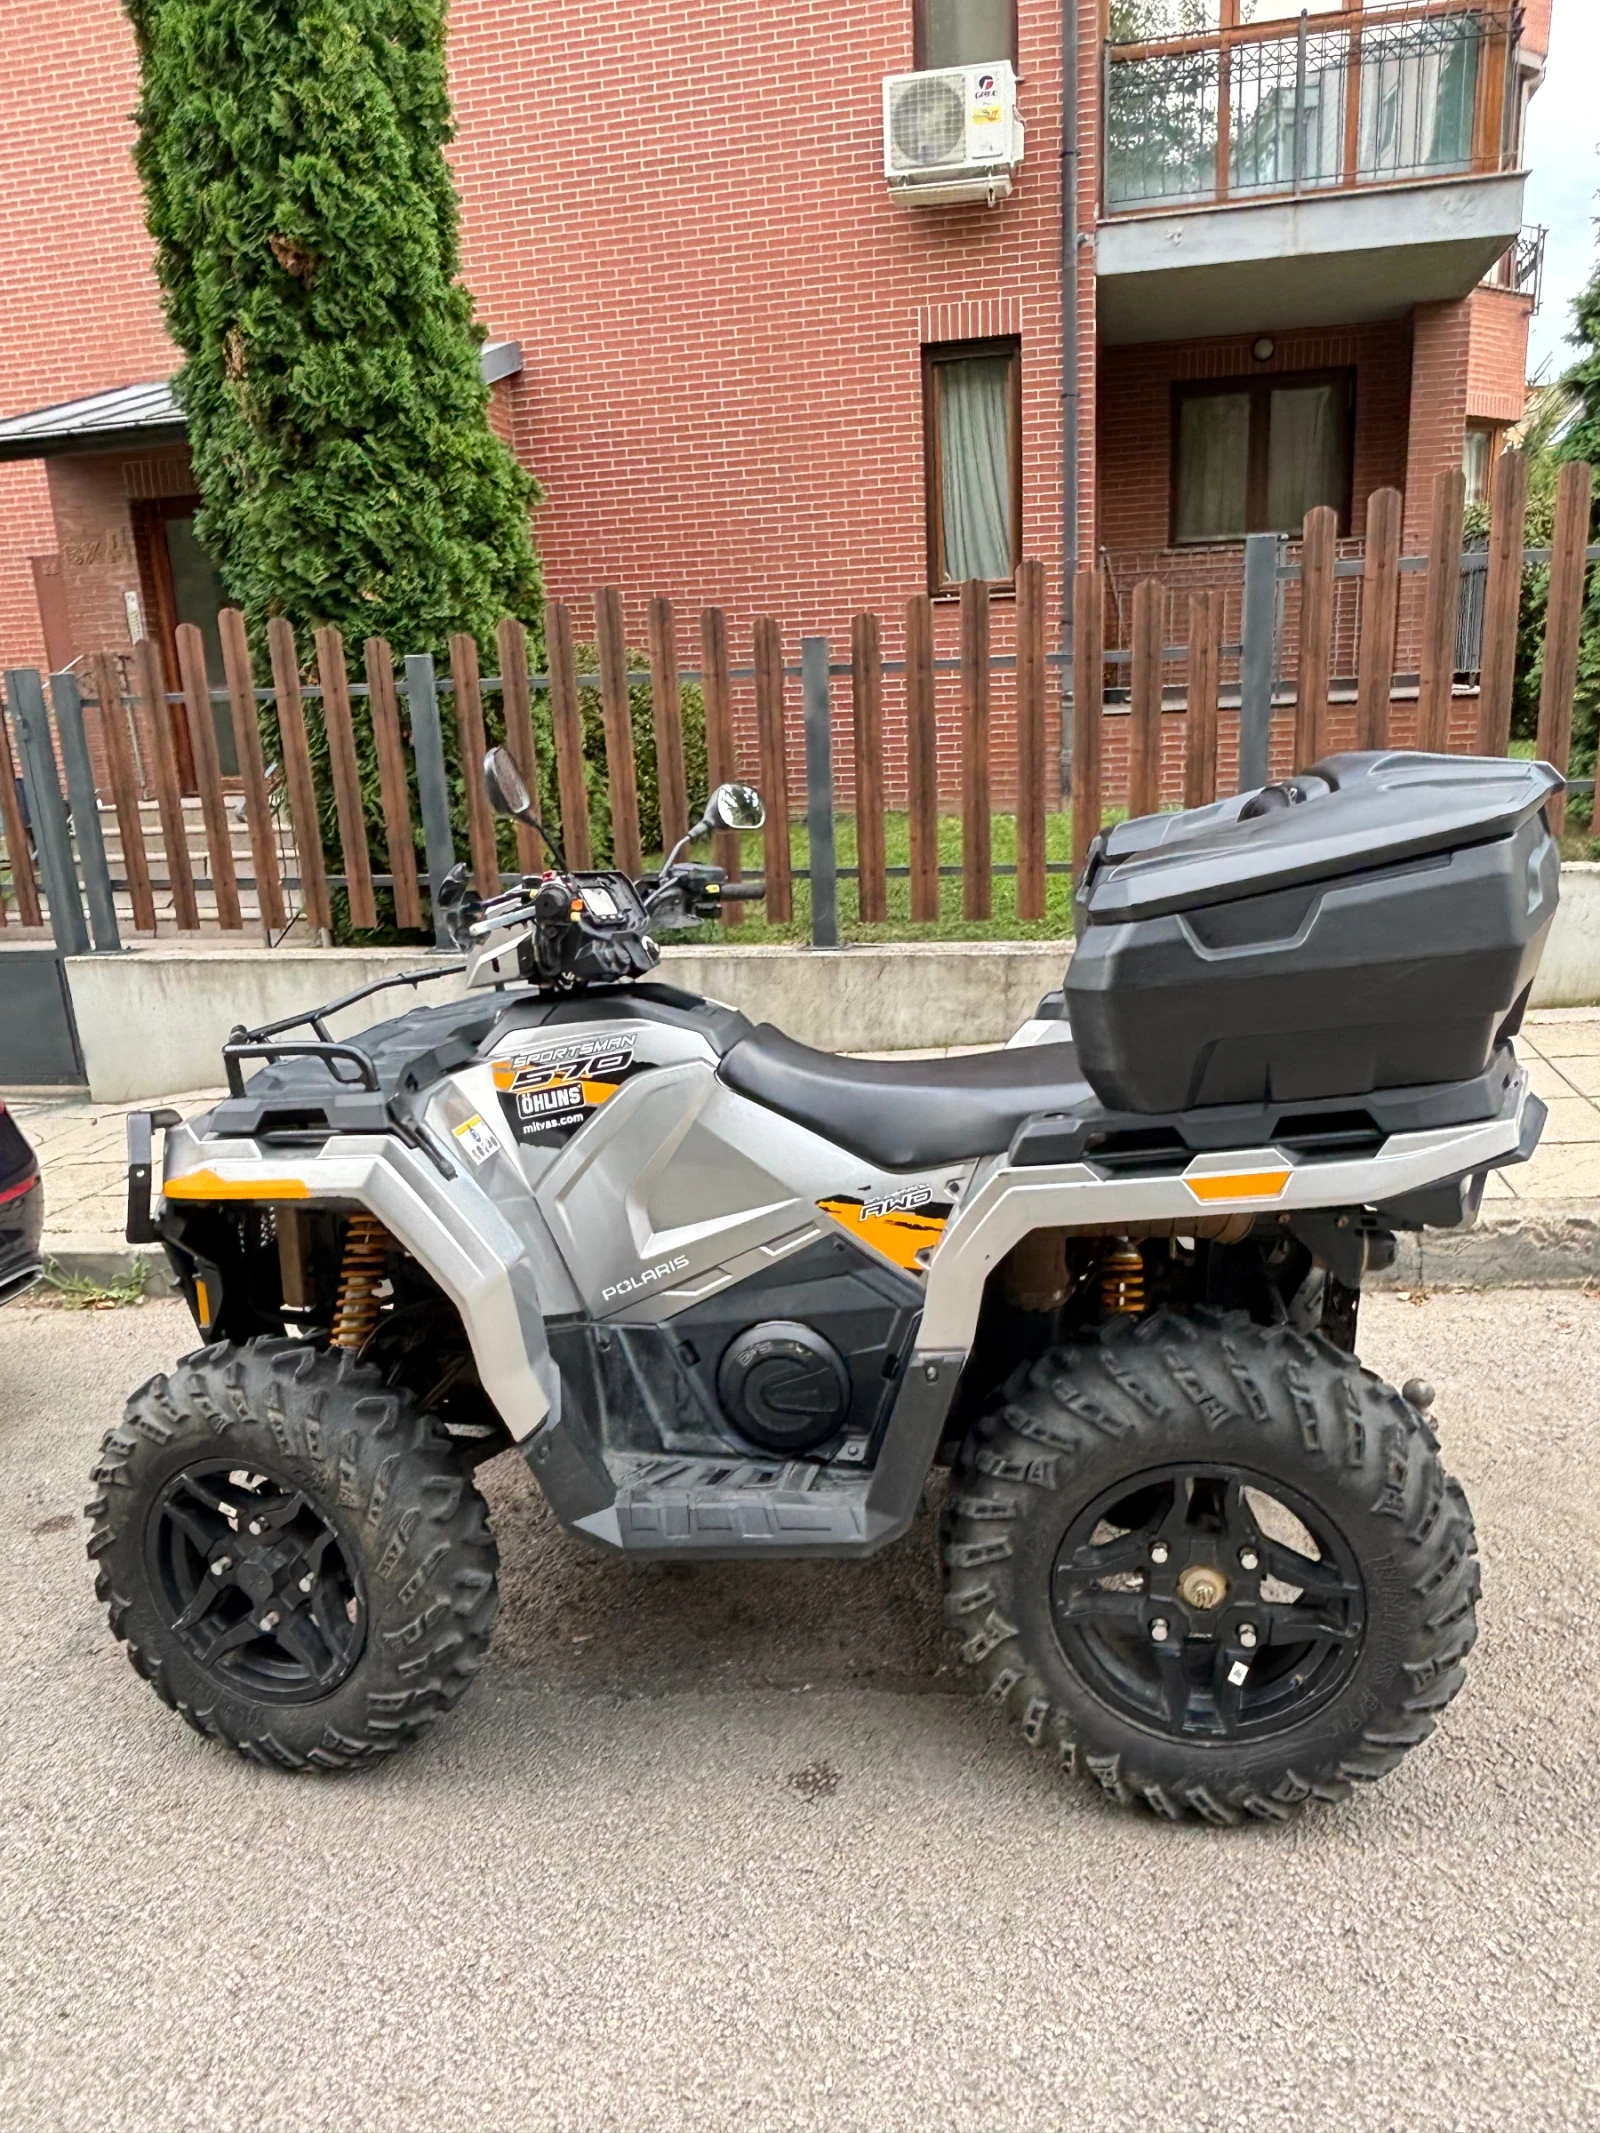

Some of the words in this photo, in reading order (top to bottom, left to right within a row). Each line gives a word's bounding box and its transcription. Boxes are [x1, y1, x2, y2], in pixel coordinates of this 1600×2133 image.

[510, 1034, 637, 1068] SPORTSMAN
[509, 1048, 634, 1092] 570
[522, 1089, 581, 1115] ÖHLINS
[522, 1113, 584, 1135] mitvas.com
[859, 1187, 933, 1222] AWD
[602, 1255, 690, 1301] POLARIS
